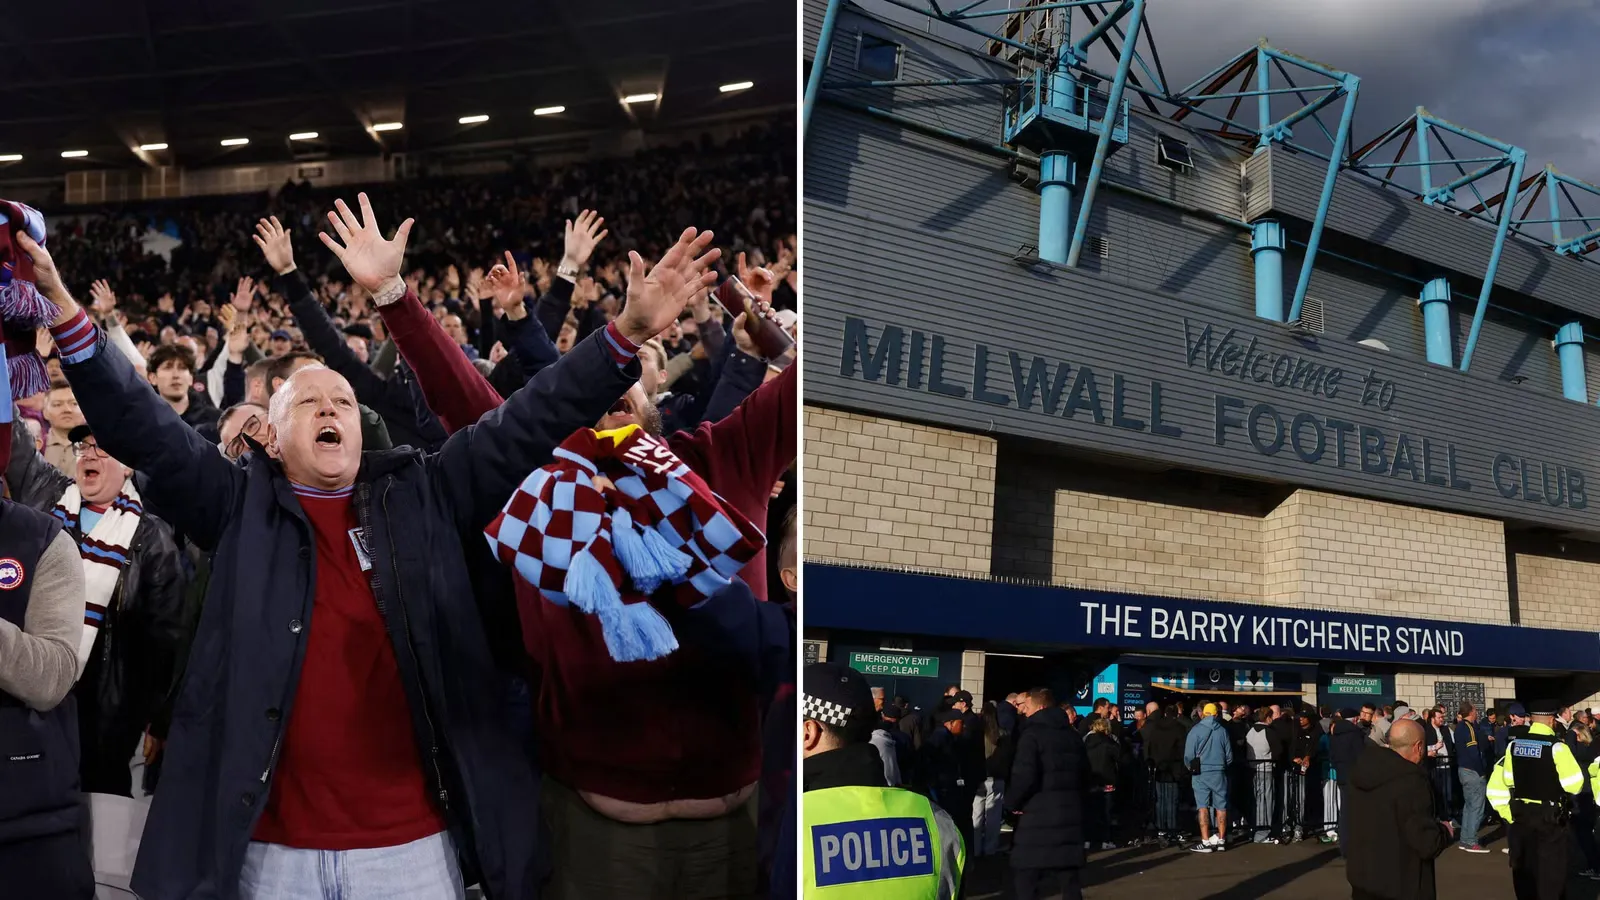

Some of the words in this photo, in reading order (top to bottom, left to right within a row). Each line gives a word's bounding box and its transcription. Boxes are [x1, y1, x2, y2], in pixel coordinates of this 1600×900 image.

[1183, 318, 1343, 398] Welcome
[1360, 368, 1396, 412] to
[839, 315, 1181, 437] MILLWALL
[1214, 393, 1471, 491] FOOTBALL
[1491, 452, 1588, 509] CLUB
[1080, 602, 1141, 638] THE
[1151, 607, 1245, 644] BARRY
[1252, 615, 1391, 653] KITCHENER
[1396, 626, 1464, 657] STAND
[855, 654, 911, 665] EMERGENCY
[911, 657, 931, 666] EXIT
[865, 664, 888, 673] KEEP
[891, 665, 919, 675] CLEAR
[1332, 678, 1366, 686] EMERGENCY
[1515, 746, 1540, 757] POLICE
[820, 827, 927, 873] POLICE
